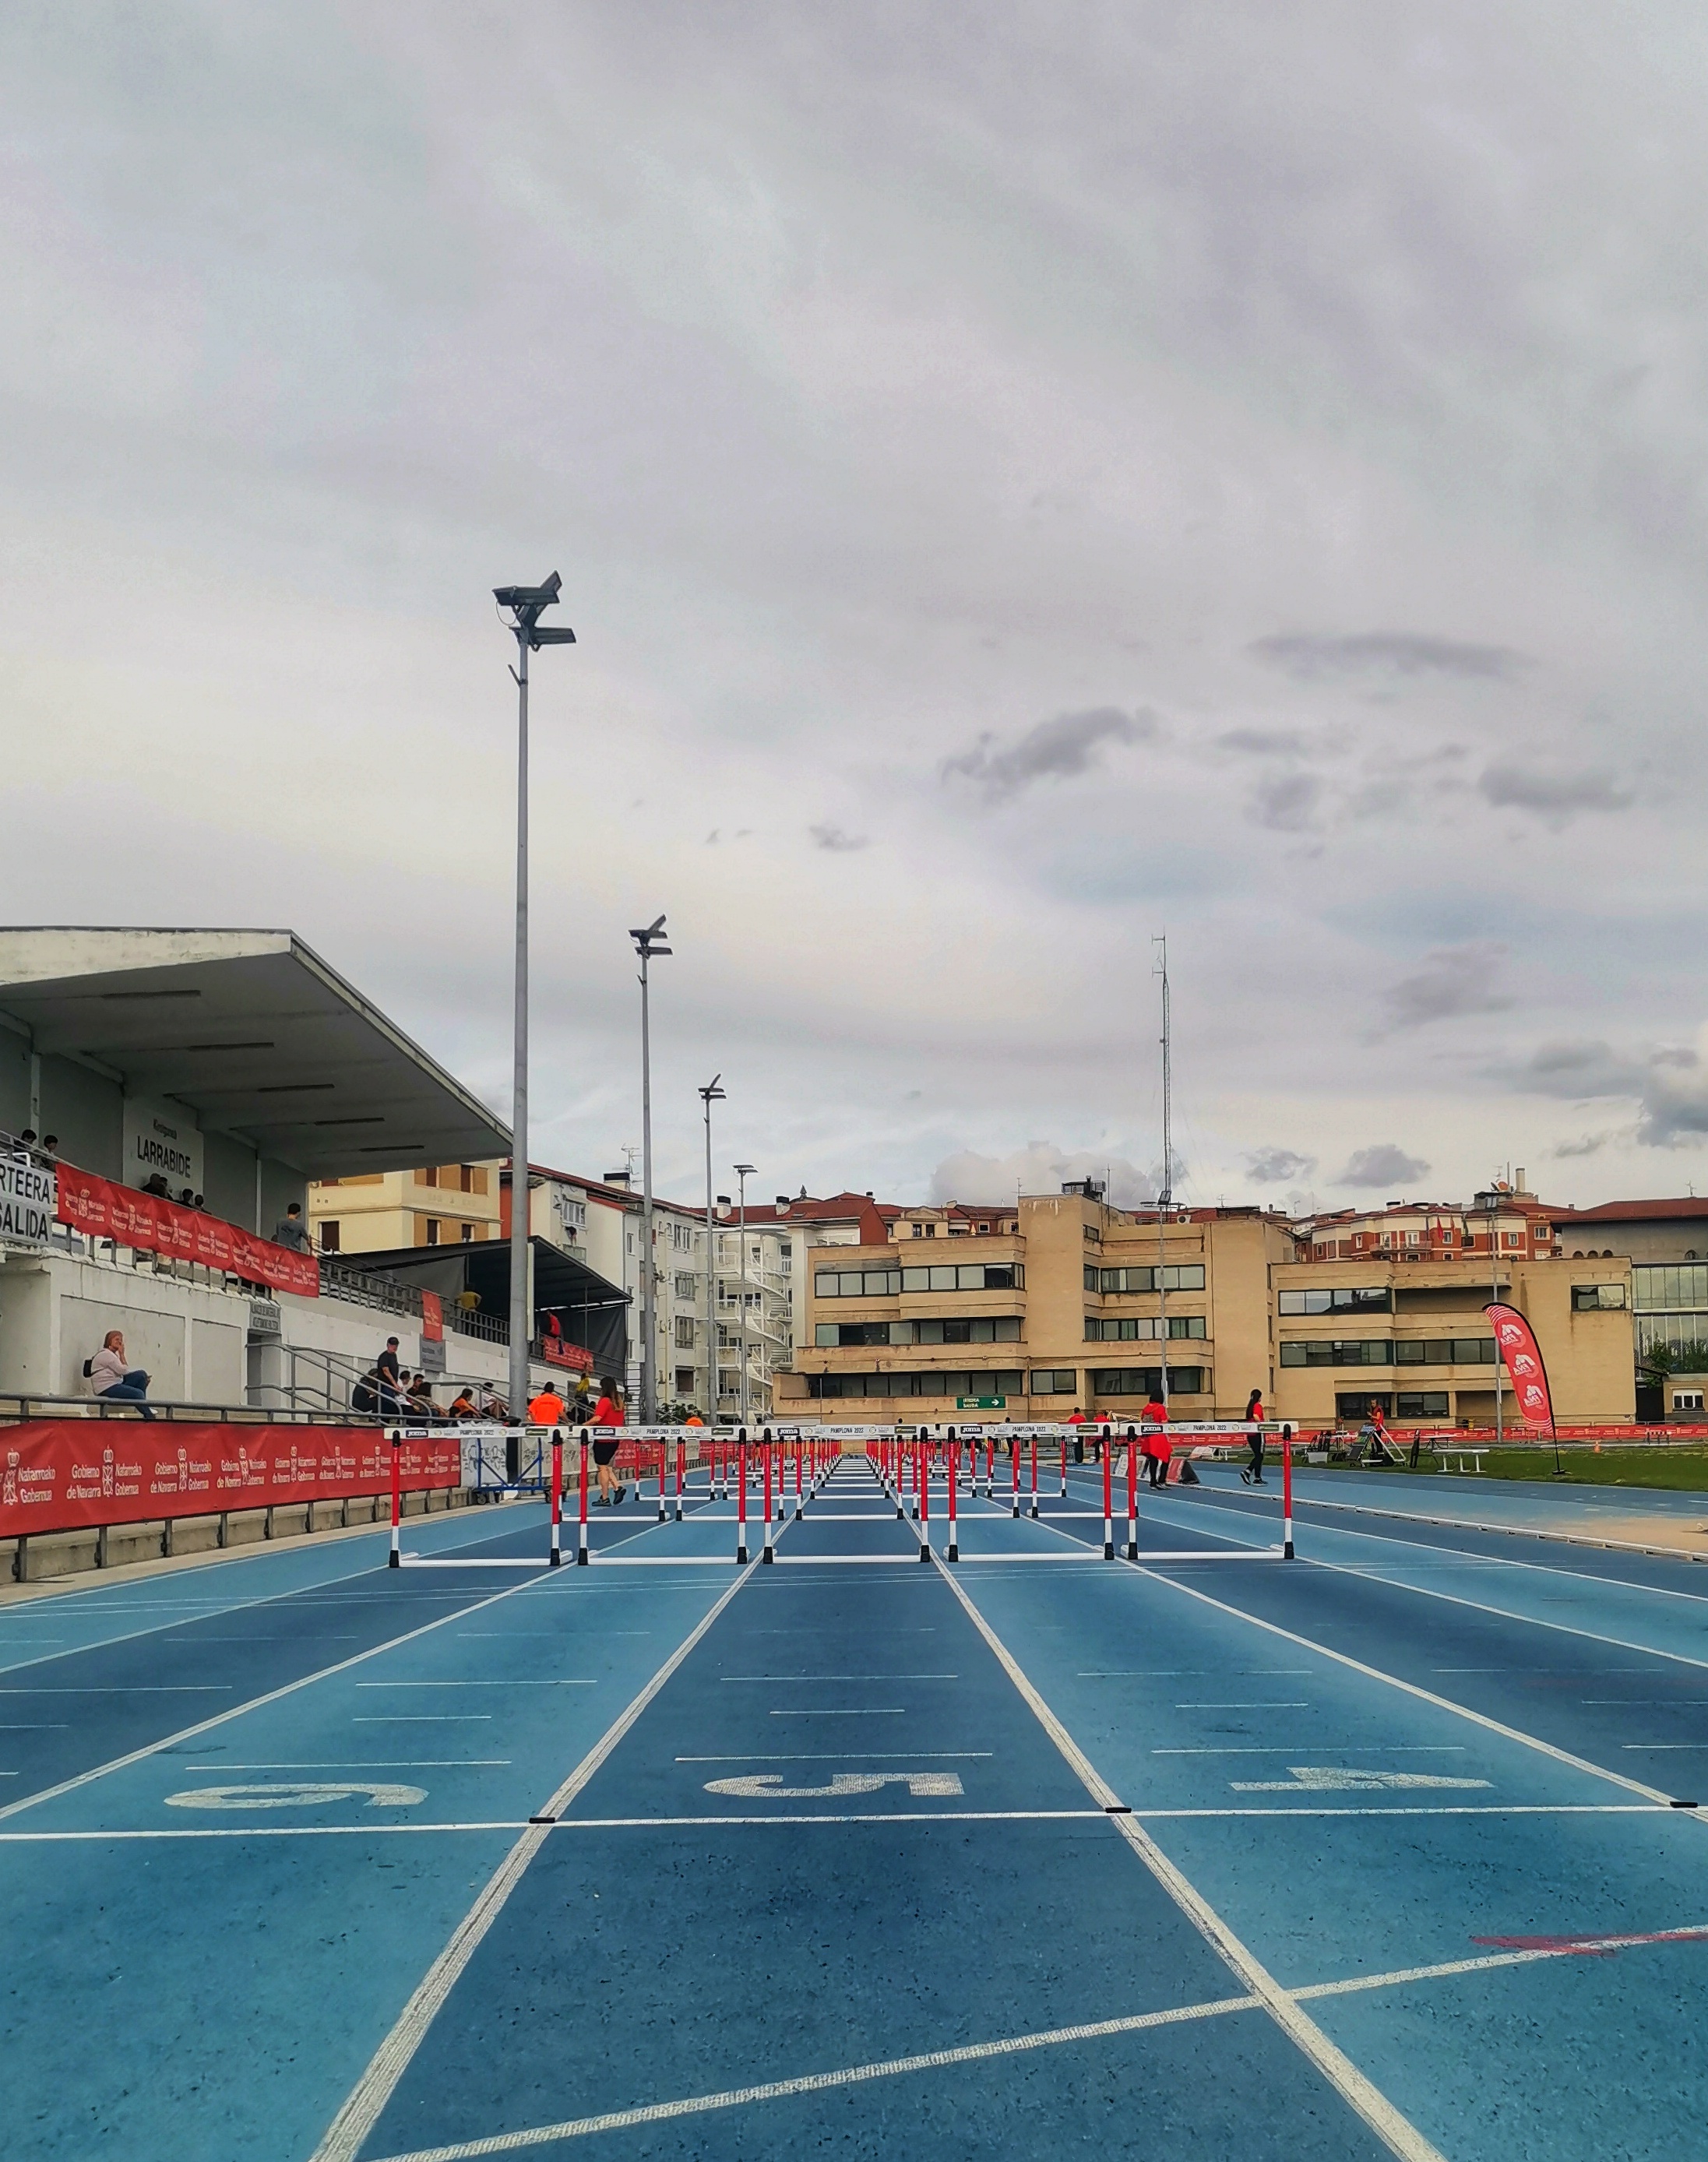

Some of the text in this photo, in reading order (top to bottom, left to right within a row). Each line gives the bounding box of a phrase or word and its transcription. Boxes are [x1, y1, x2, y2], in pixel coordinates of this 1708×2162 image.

[137, 1136, 191, 1178] LARRABIDE
[163, 1783, 430, 1809] 6
[703, 1772, 965, 1796] 5
